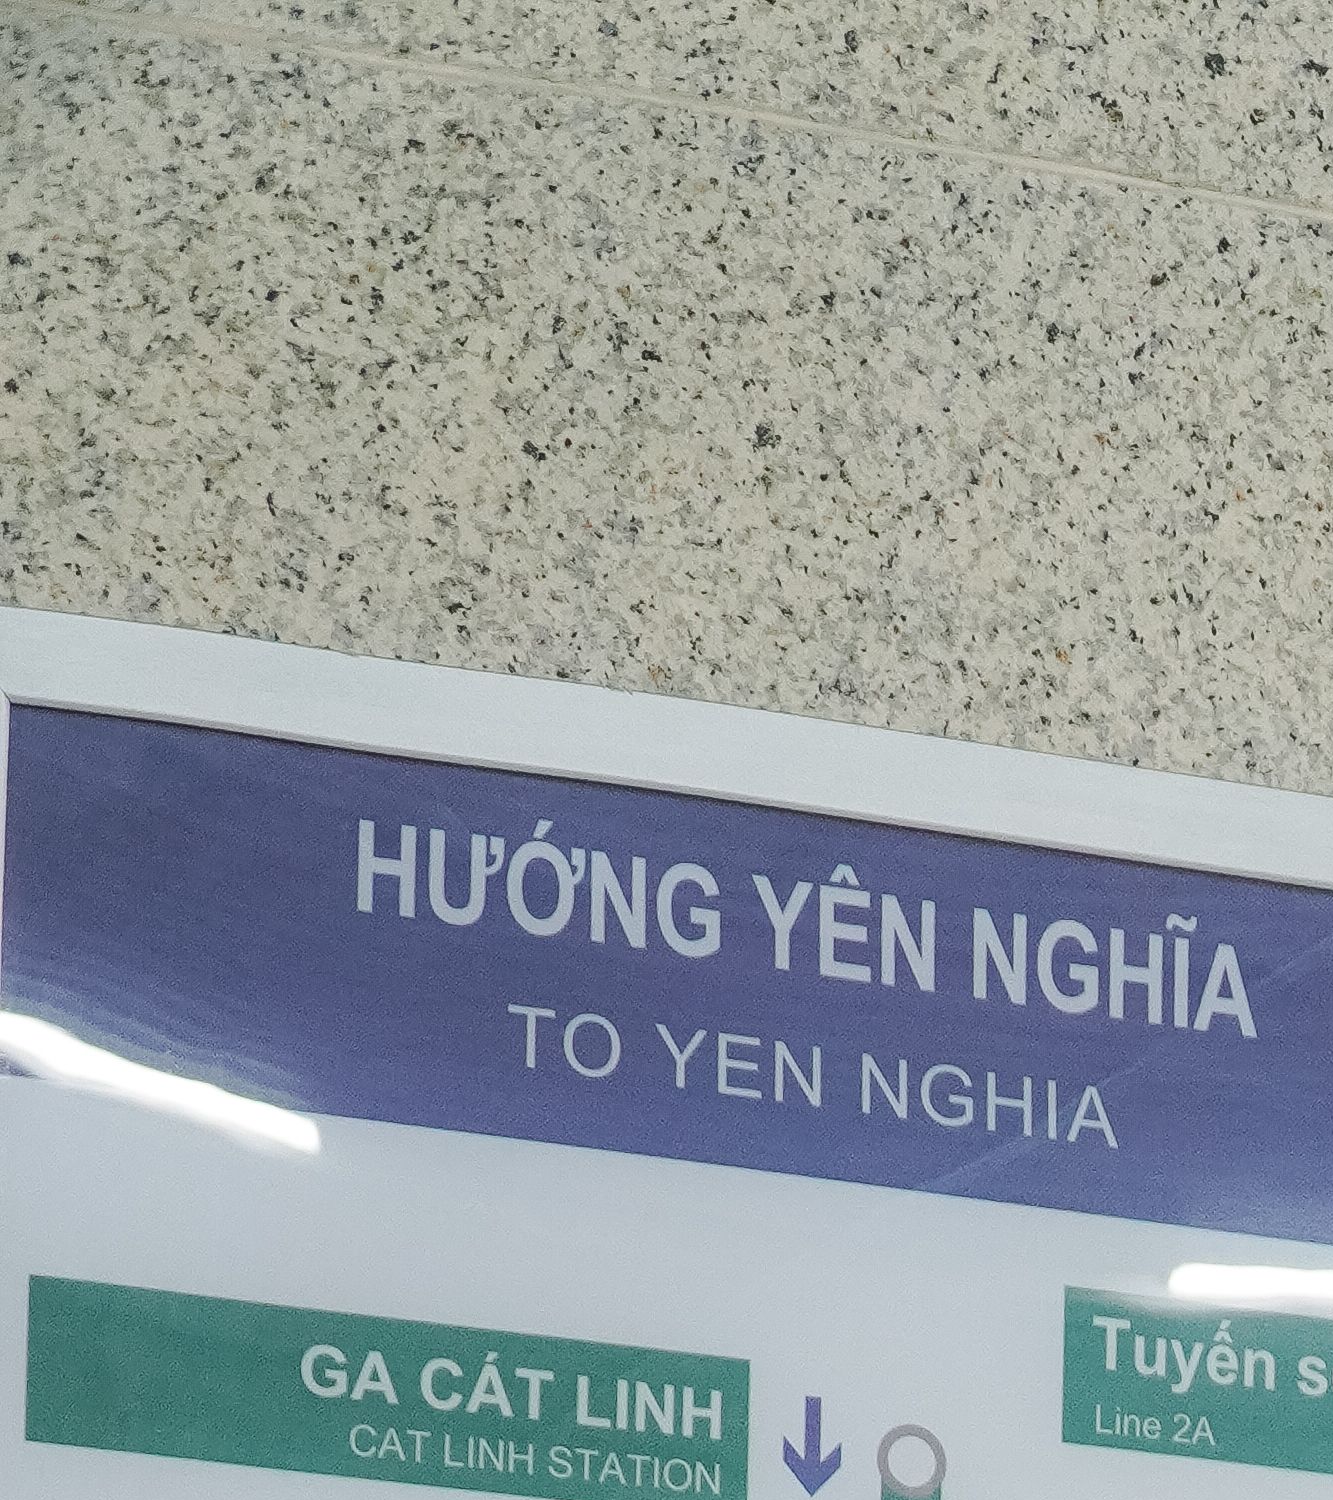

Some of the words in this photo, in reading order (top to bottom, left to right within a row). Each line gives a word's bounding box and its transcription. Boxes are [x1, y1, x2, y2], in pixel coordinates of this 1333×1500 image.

[357, 819, 720, 959] HƯỚNG
[752, 864, 935, 992] YÊN
[973, 908, 1257, 1038] NGHĨA
[508, 1004, 620, 1077] TO
[656, 1024, 821, 1107] YEN
[862, 1053, 1118, 1149] NGHIA
[301, 1344, 399, 1404] GA
[421, 1351, 554, 1420] CÁT
[577, 1375, 722, 1439] LINH
[1092, 1312, 1281, 1393] Tuyến
[350, 1425, 431, 1463] CAT
[444, 1432, 533, 1475] LINH
[549, 1446, 720, 1494] STATION
[1096, 1404, 1161, 1439] Line
[1173, 1414, 1215, 1445] 2A
